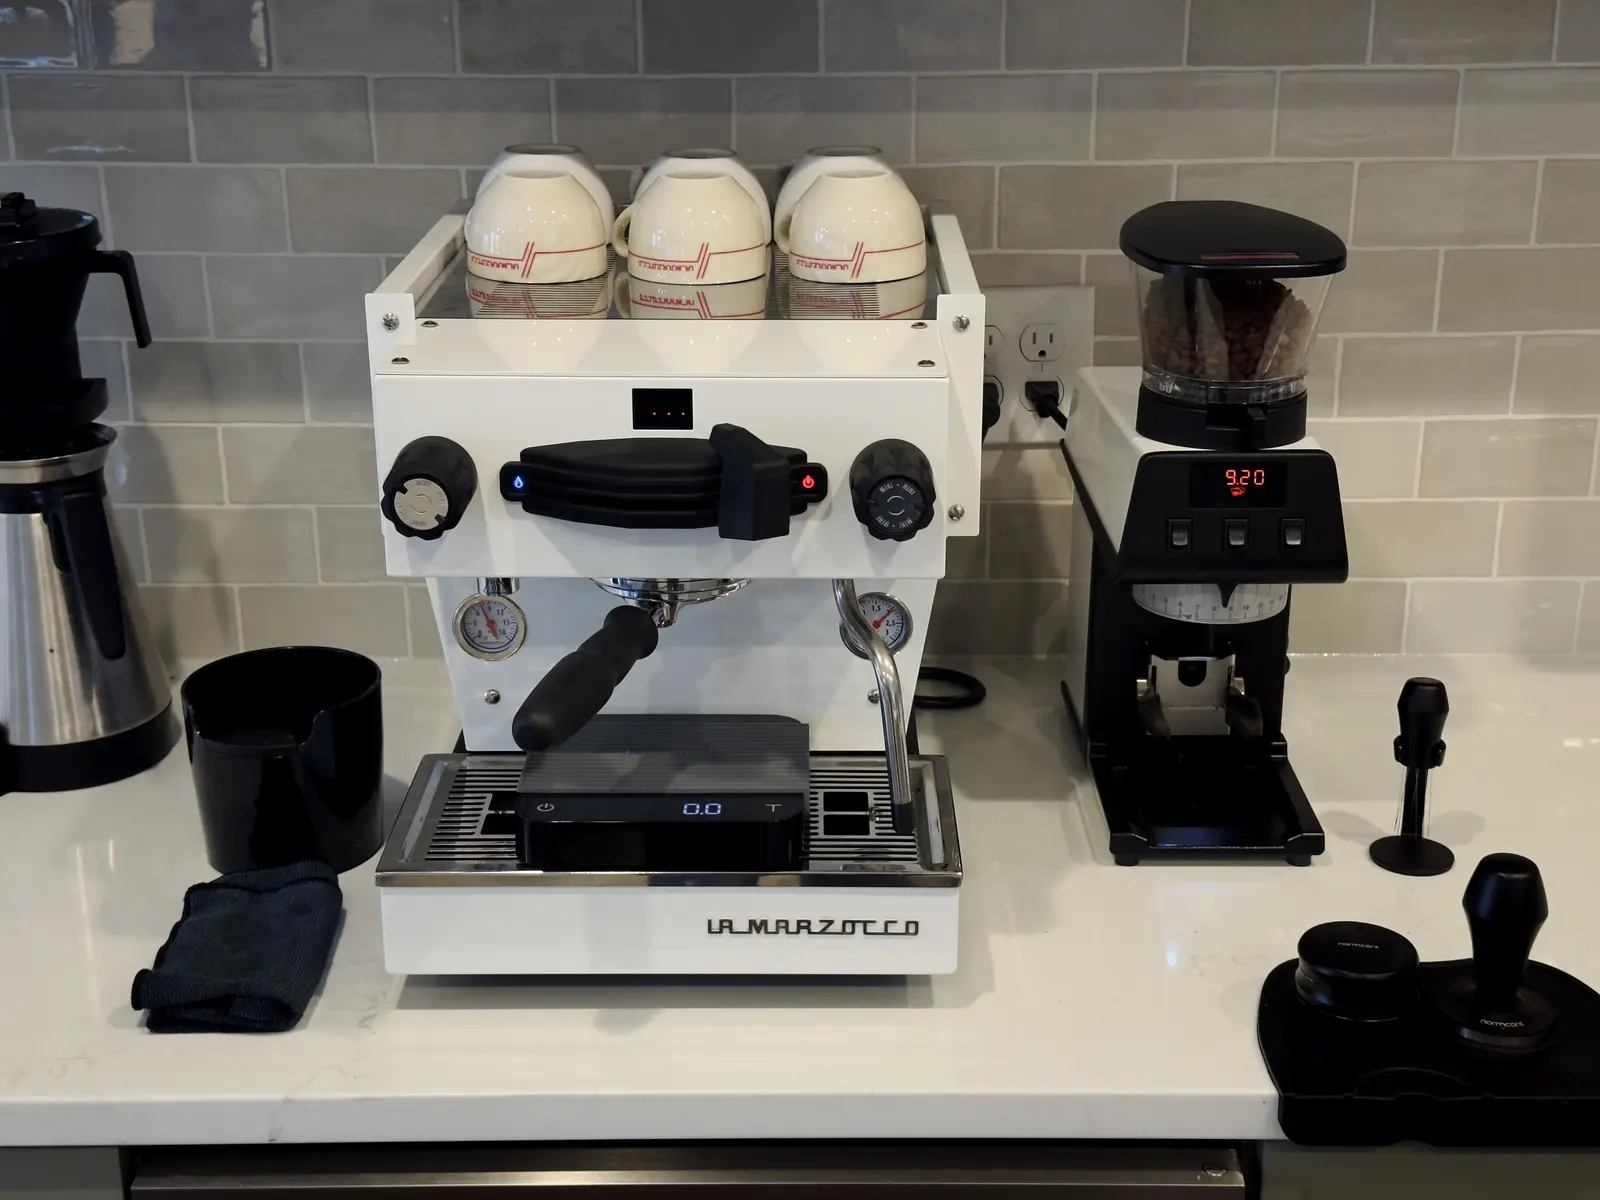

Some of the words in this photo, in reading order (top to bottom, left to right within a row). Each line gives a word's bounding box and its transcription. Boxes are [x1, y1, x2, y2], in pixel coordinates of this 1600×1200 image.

[1225, 469, 1265, 486] 9.20
[496, 608, 505, 616] 12
[683, 803, 722, 815] 0.0
[707, 918, 733, 935] LA
[748, 918, 919, 936] MARZOCCO
[1480, 1018, 1525, 1028] normcore
